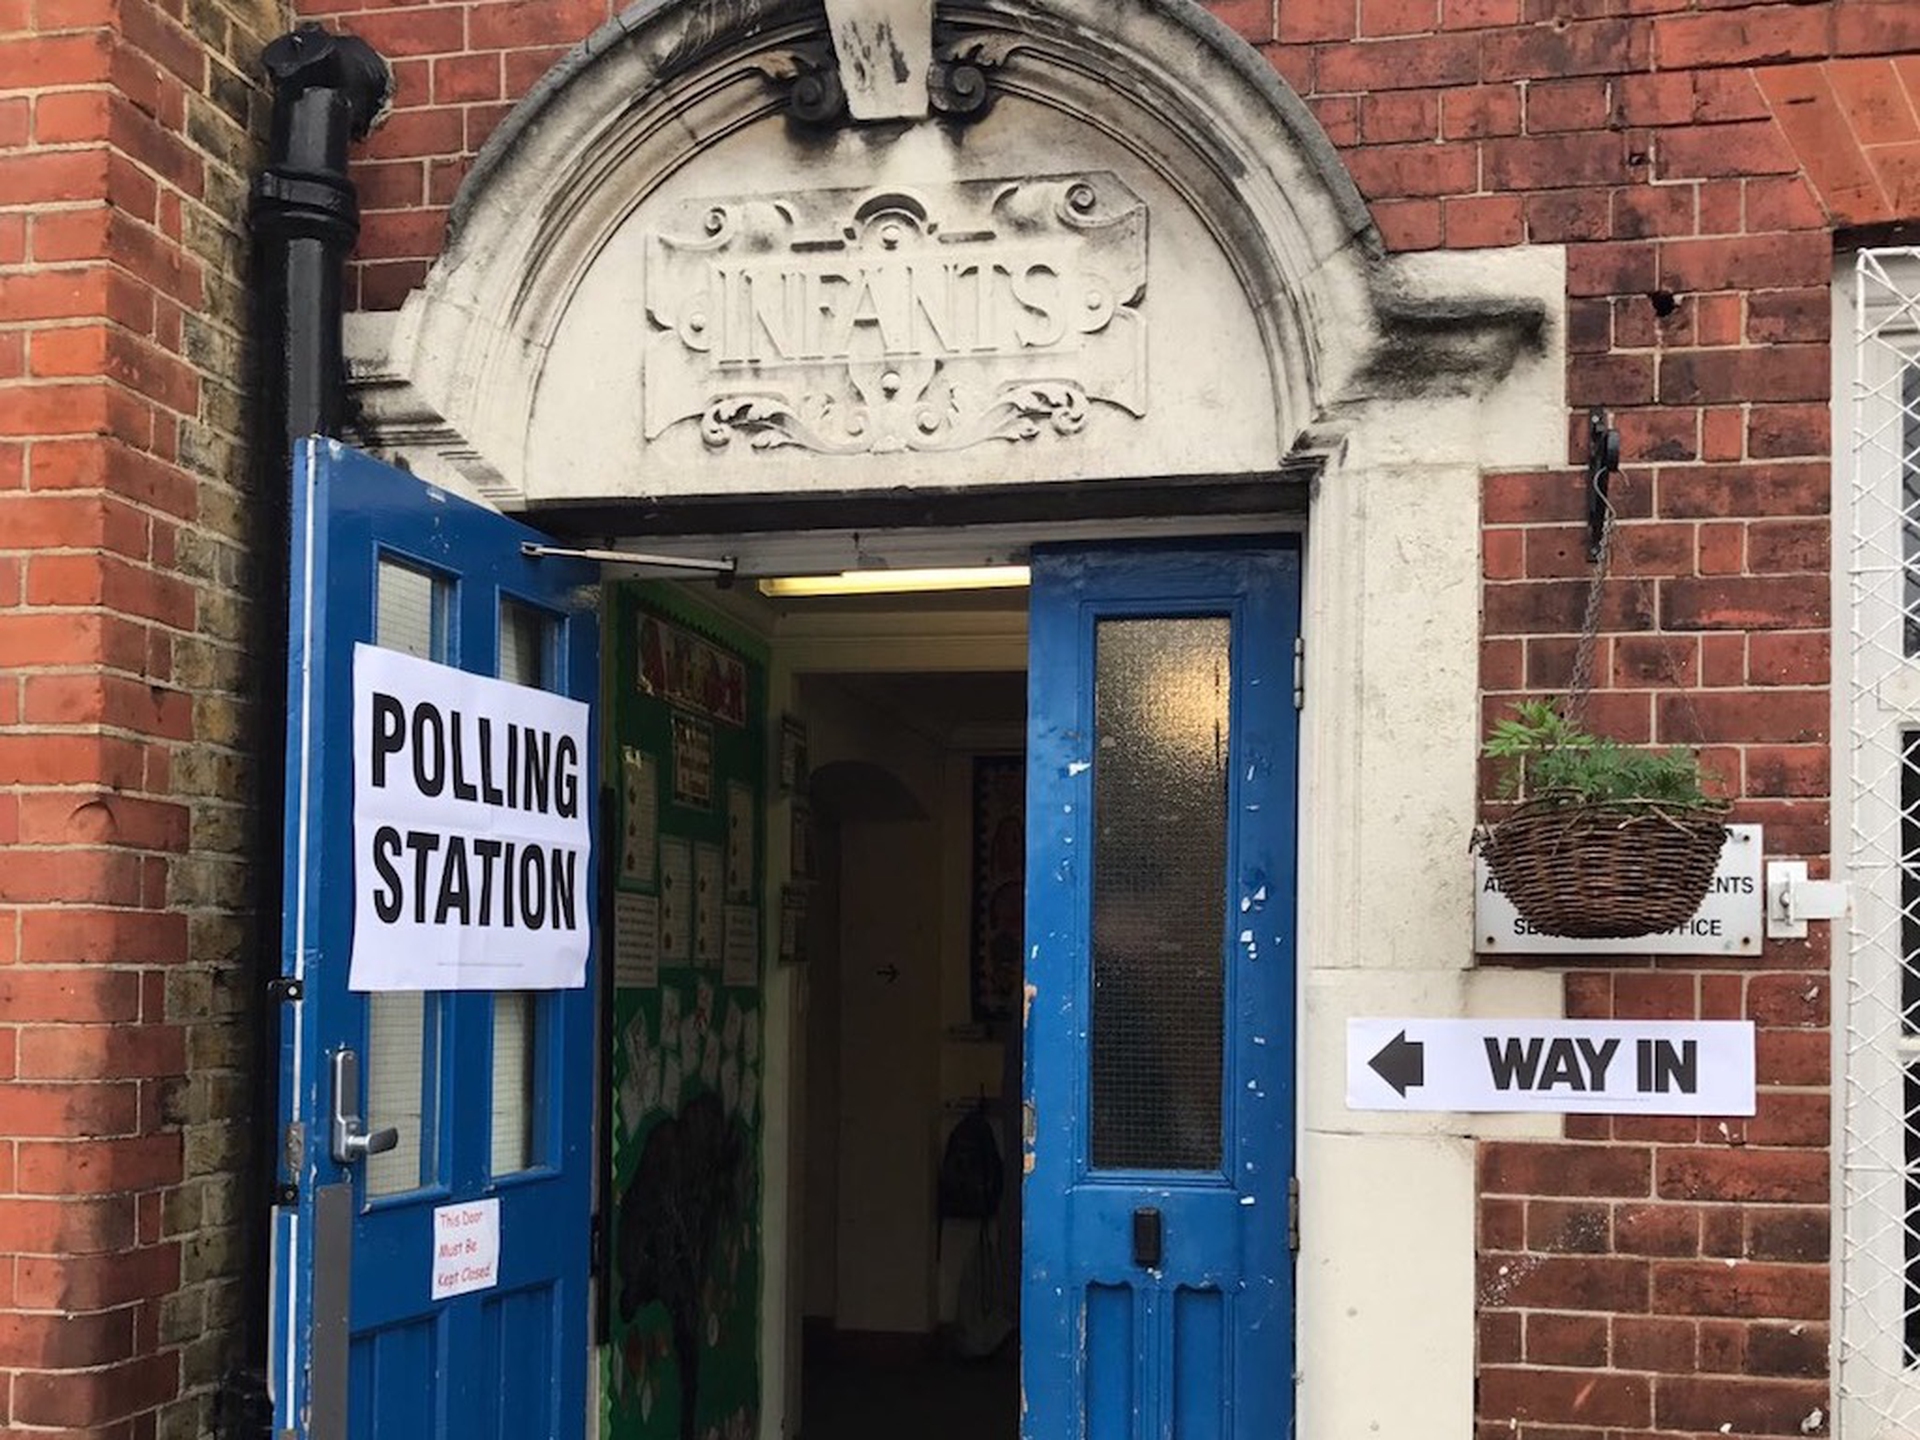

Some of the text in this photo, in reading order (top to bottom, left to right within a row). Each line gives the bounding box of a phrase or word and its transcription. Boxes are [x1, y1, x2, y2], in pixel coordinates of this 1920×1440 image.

[717, 263, 1066, 364] INFANTS
[371, 692, 578, 819] POLLING
[373, 826, 577, 931] STATION
[1483, 1037, 1697, 1094] WAY IN
[439, 1238, 477, 1258] Must Be
[440, 1210, 482, 1229] This Door
[438, 1263, 491, 1289] Kept Closed
